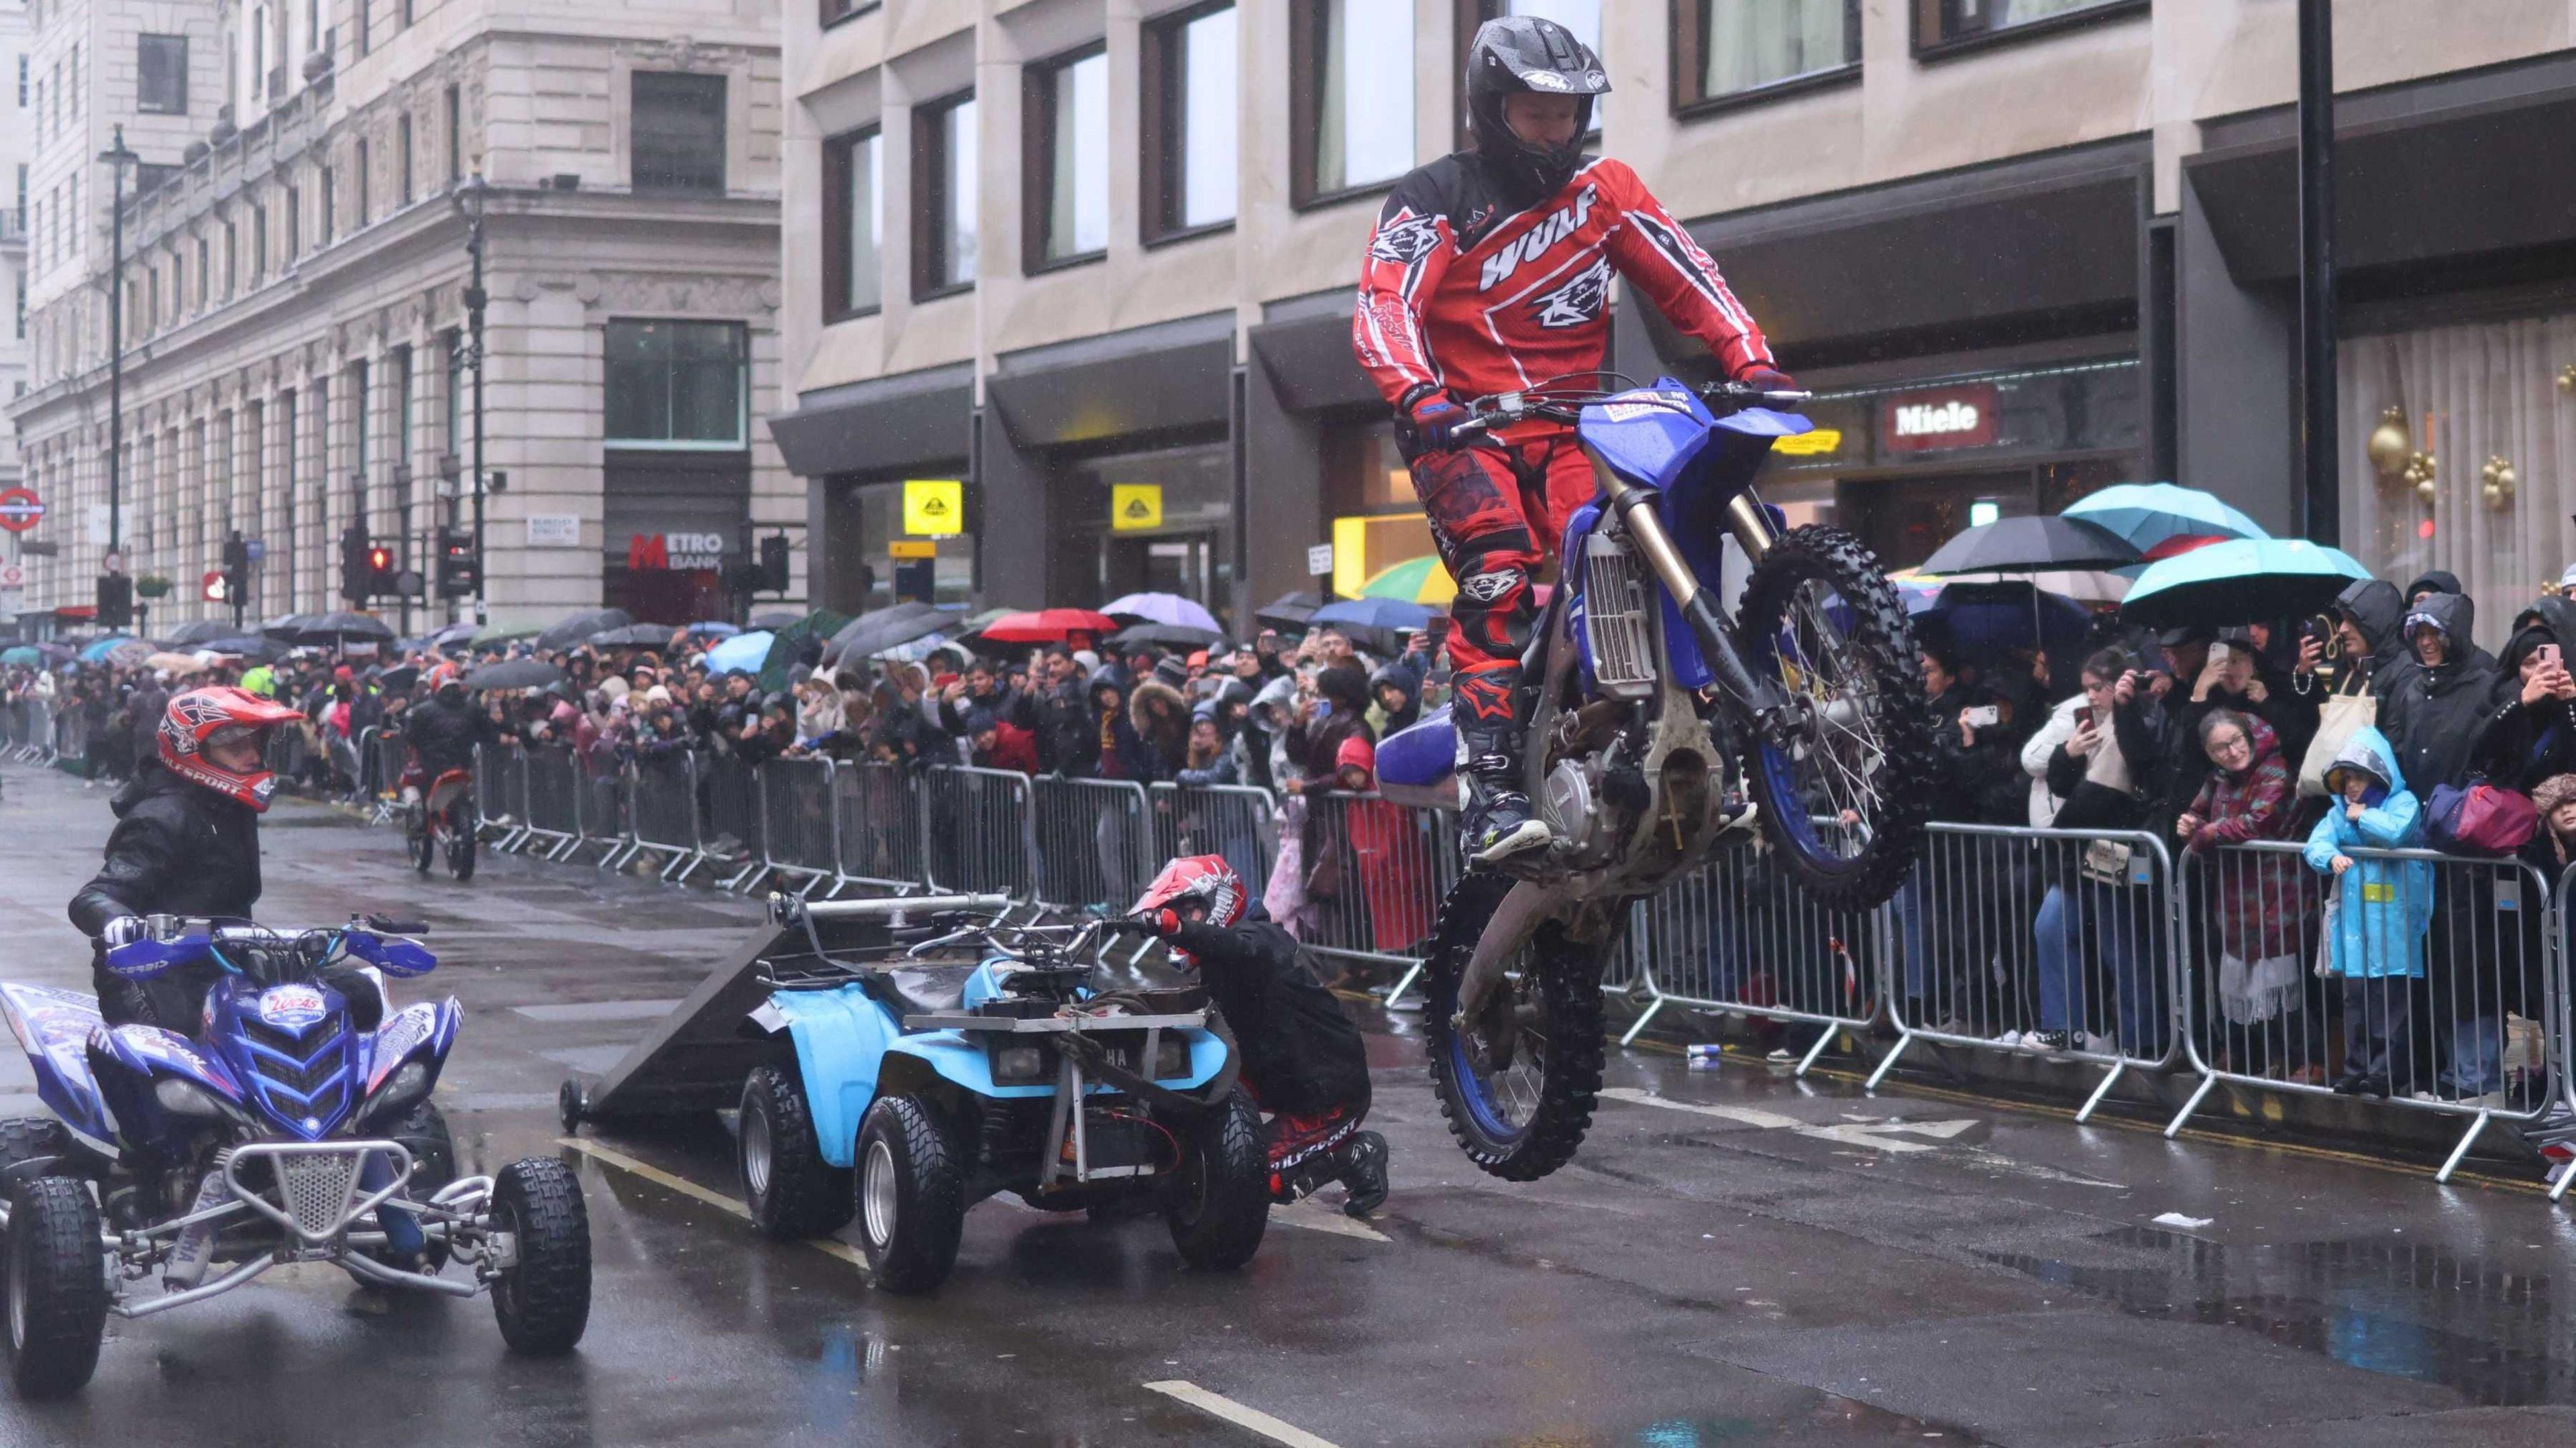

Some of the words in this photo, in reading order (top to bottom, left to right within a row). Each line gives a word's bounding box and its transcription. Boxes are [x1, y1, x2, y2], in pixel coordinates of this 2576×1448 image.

[1479, 182, 1597, 294] WULF
[1896, 401, 1978, 436] Miele
[629, 533, 722, 569] METRO
[669, 554, 722, 575] BANK
[271, 997, 319, 1011] LUCAS
